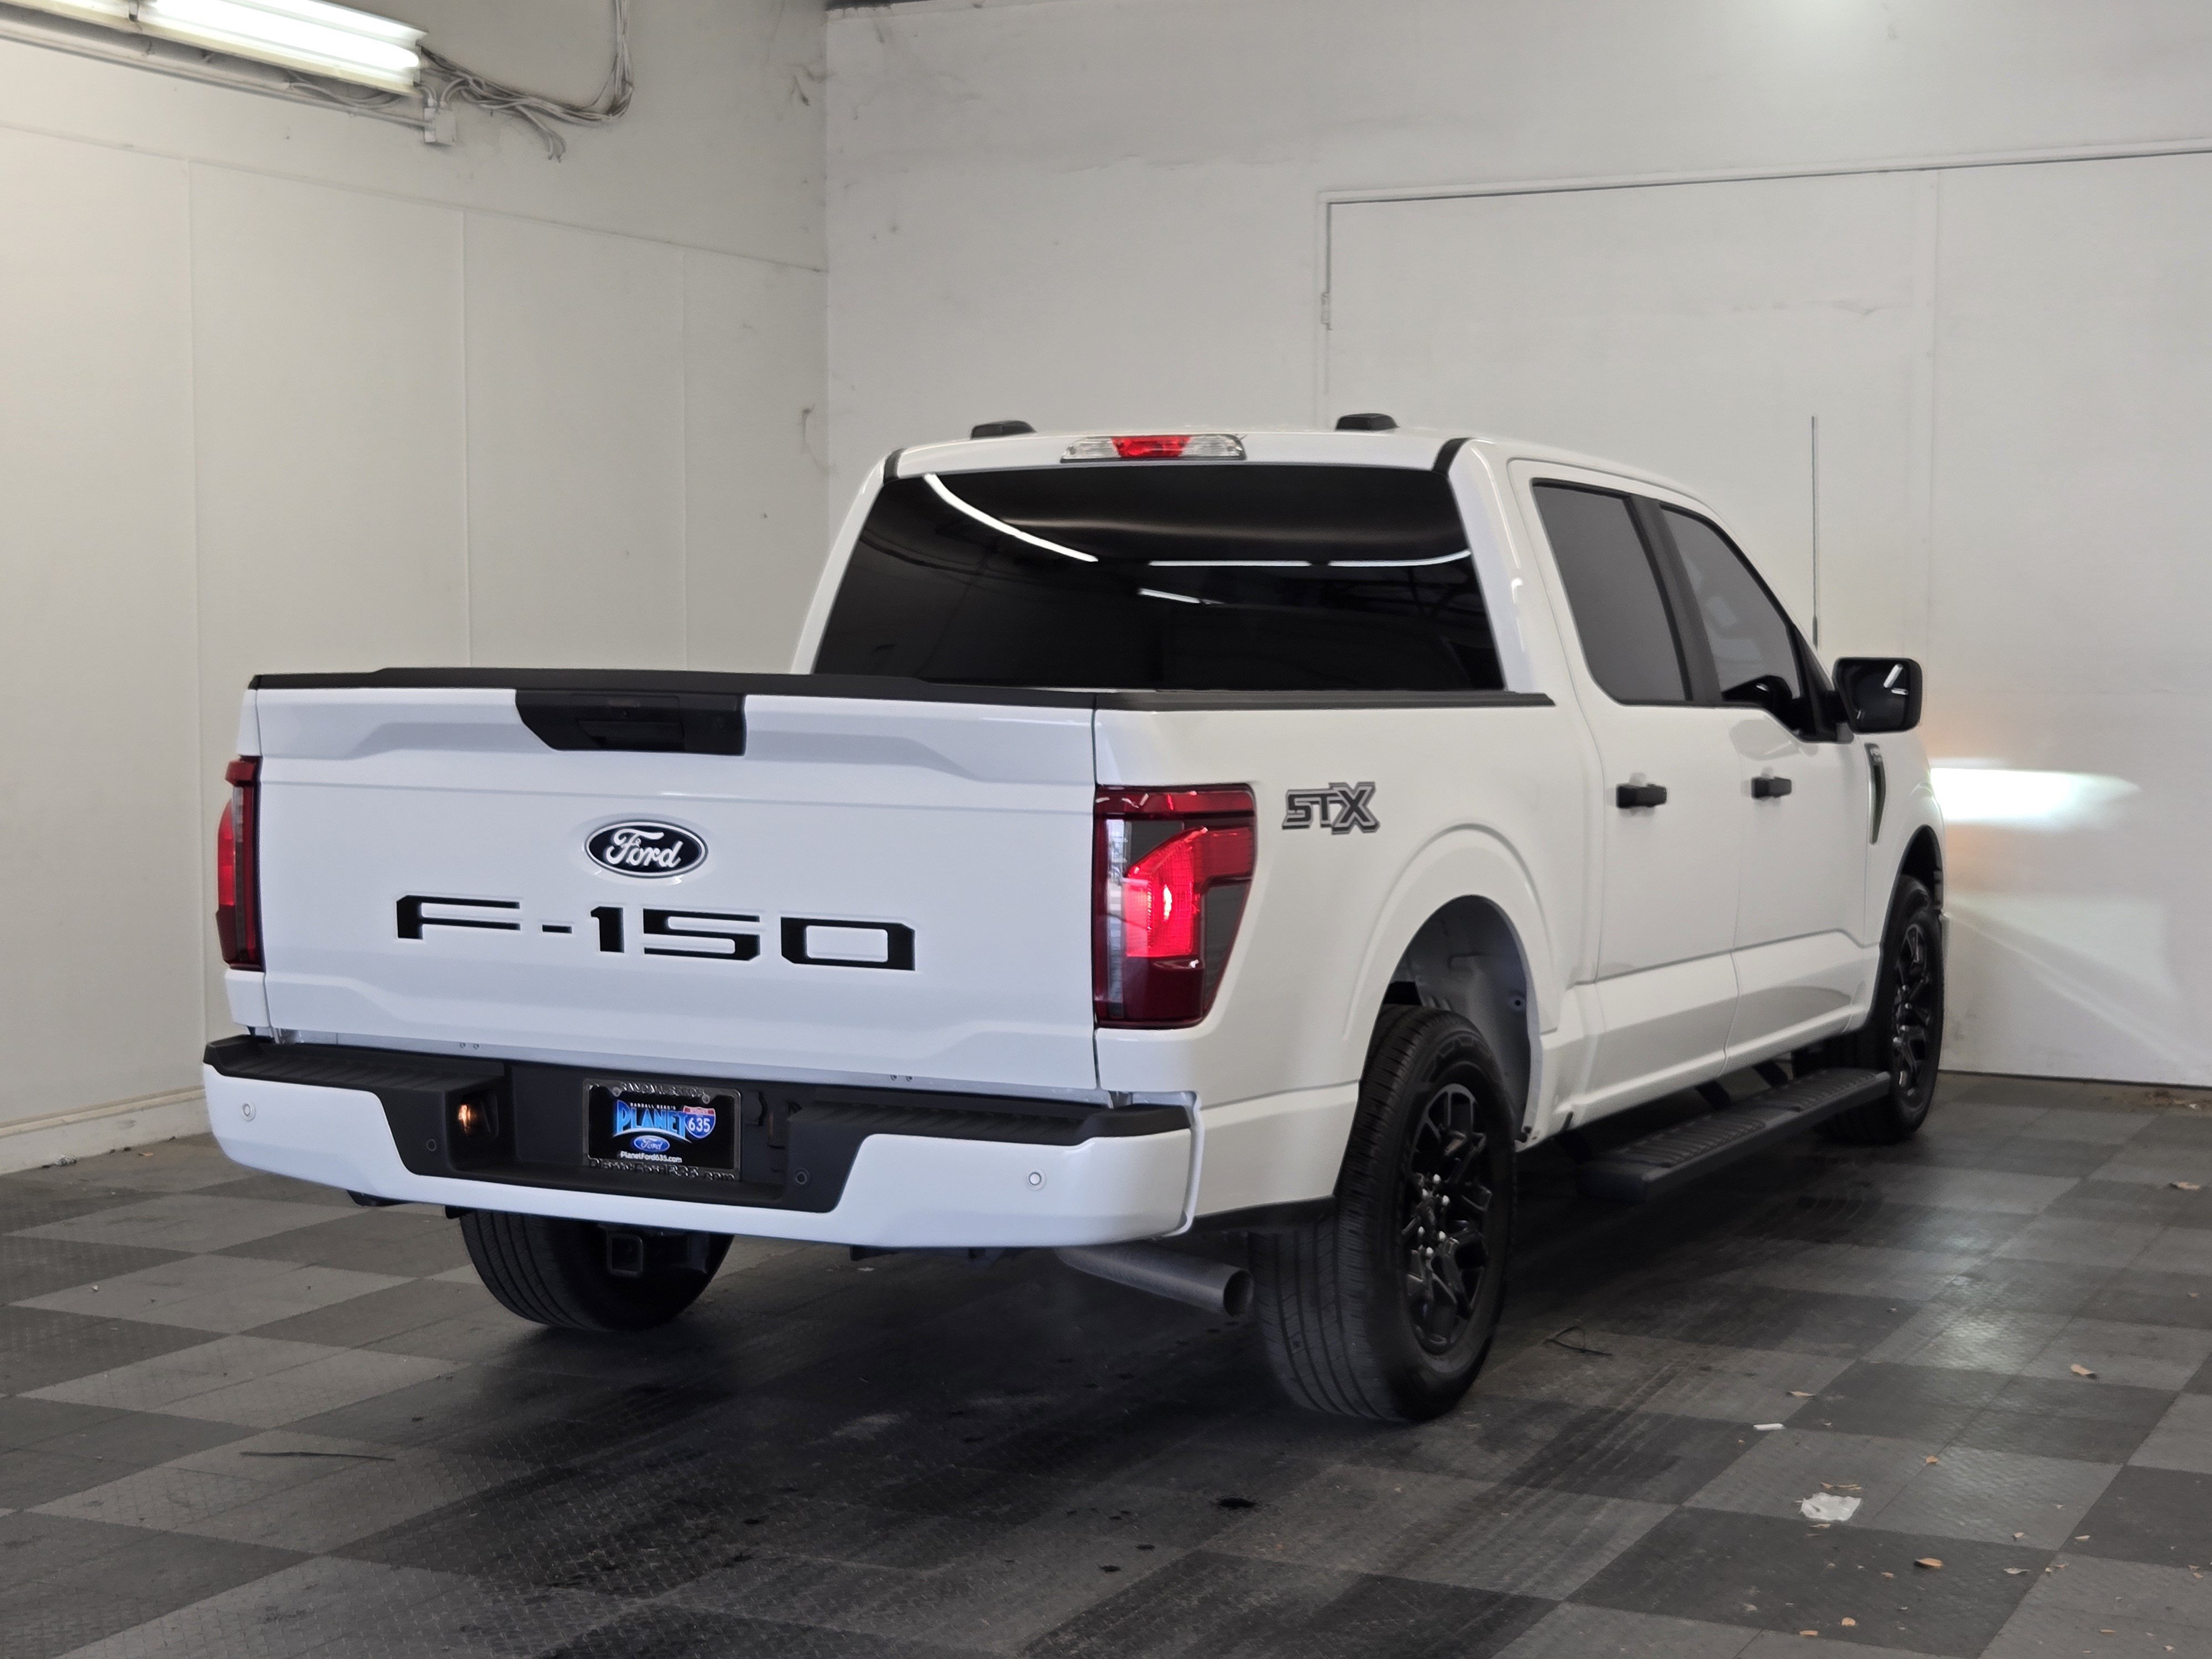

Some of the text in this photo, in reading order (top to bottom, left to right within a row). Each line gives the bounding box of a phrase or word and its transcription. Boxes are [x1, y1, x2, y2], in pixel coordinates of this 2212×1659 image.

[1281, 781, 1380, 835] STX
[606, 828, 684, 868] Ford
[396, 894, 916, 971] F-150
[617, 1099, 688, 1139] PLANET
[688, 1117, 711, 1133] 635
[640, 1138, 664, 1150] Ford
